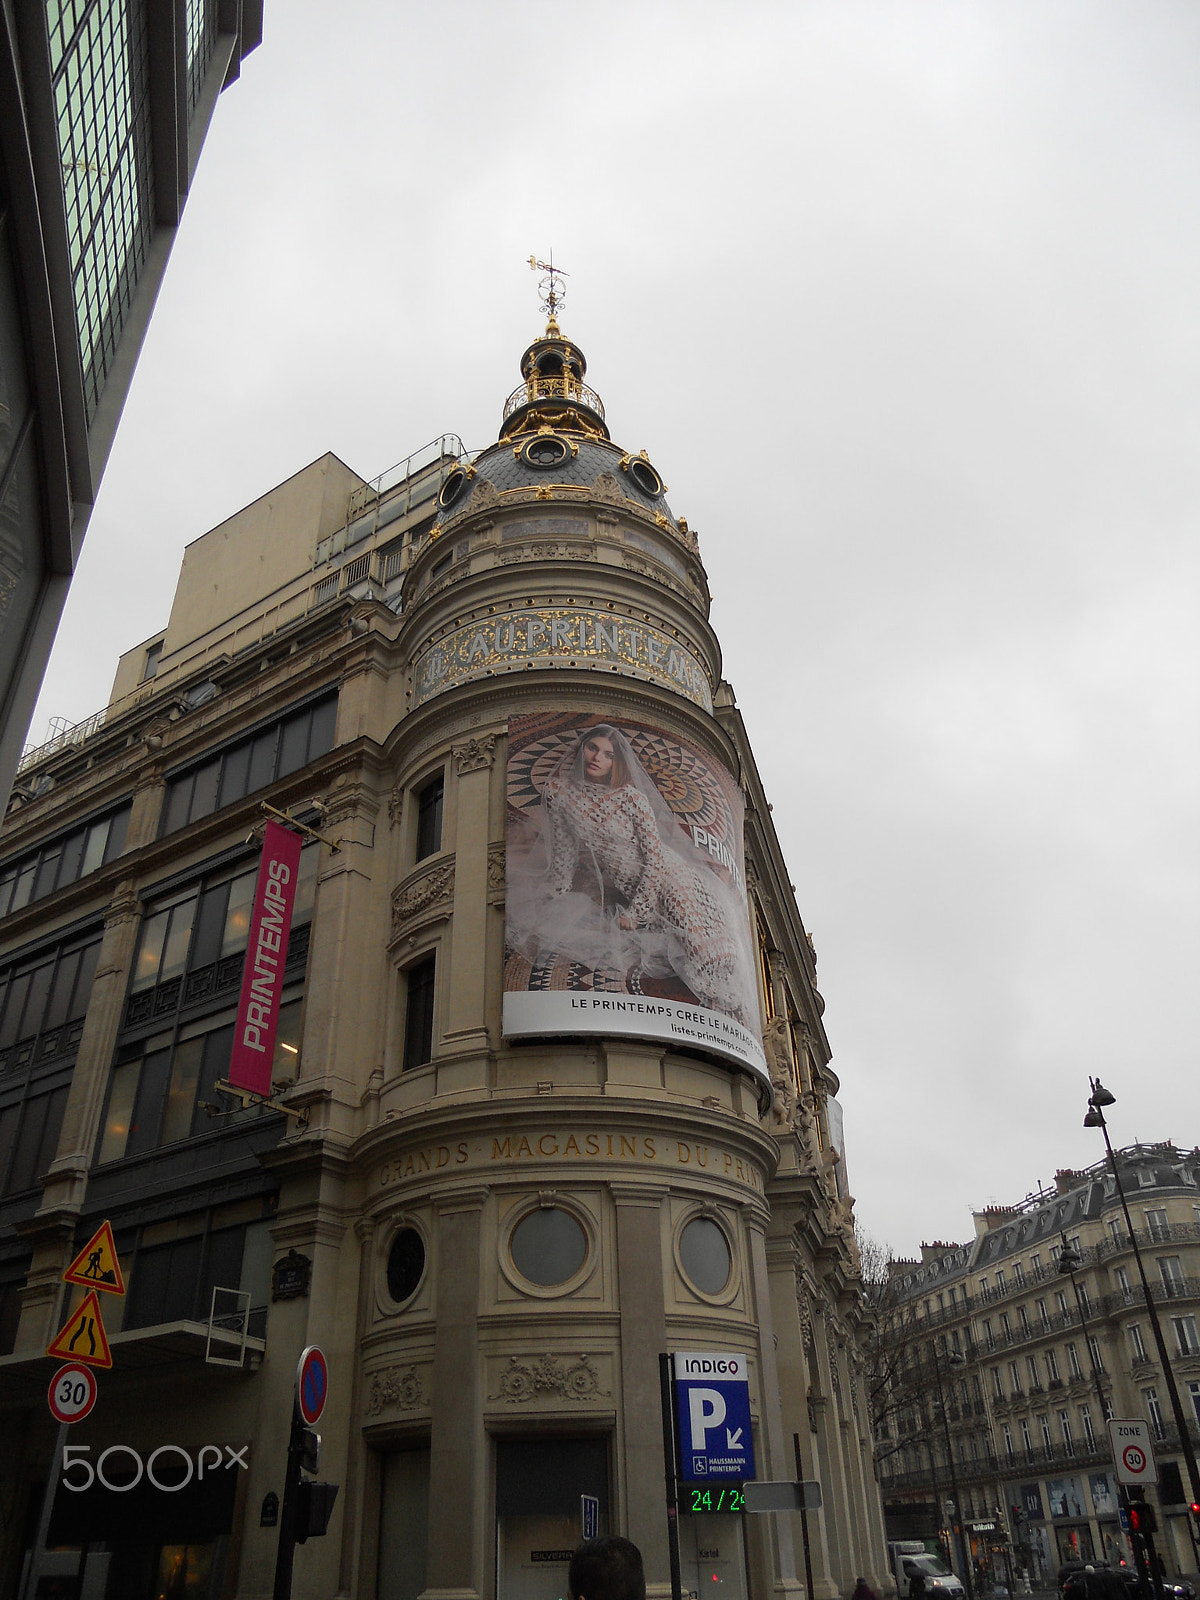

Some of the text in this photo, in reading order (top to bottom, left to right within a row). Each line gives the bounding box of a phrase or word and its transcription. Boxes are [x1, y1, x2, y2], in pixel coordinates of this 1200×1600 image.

[467, 623, 516, 663] AU
[243, 860, 291, 1053] PRINTEMPS
[571, 998, 587, 1009] LE
[593, 1000, 672, 1018] PRINTEMPS
[676, 1009, 705, 1025] CRÉE
[708, 1017, 720, 1030] LE
[380, 1143, 469, 1186] GRANDS
[491, 1134, 657, 1160] MAGASINS
[677, 1142, 708, 1167] DU
[685, 1359, 739, 1375] INDIGO
[59, 1380, 86, 1406] 30
[688, 1387, 727, 1451] P
[1118, 1426, 1141, 1437] ZONE
[709, 1457, 746, 1465] HAUSSMANN
[1127, 1453, 1141, 1466] 30
